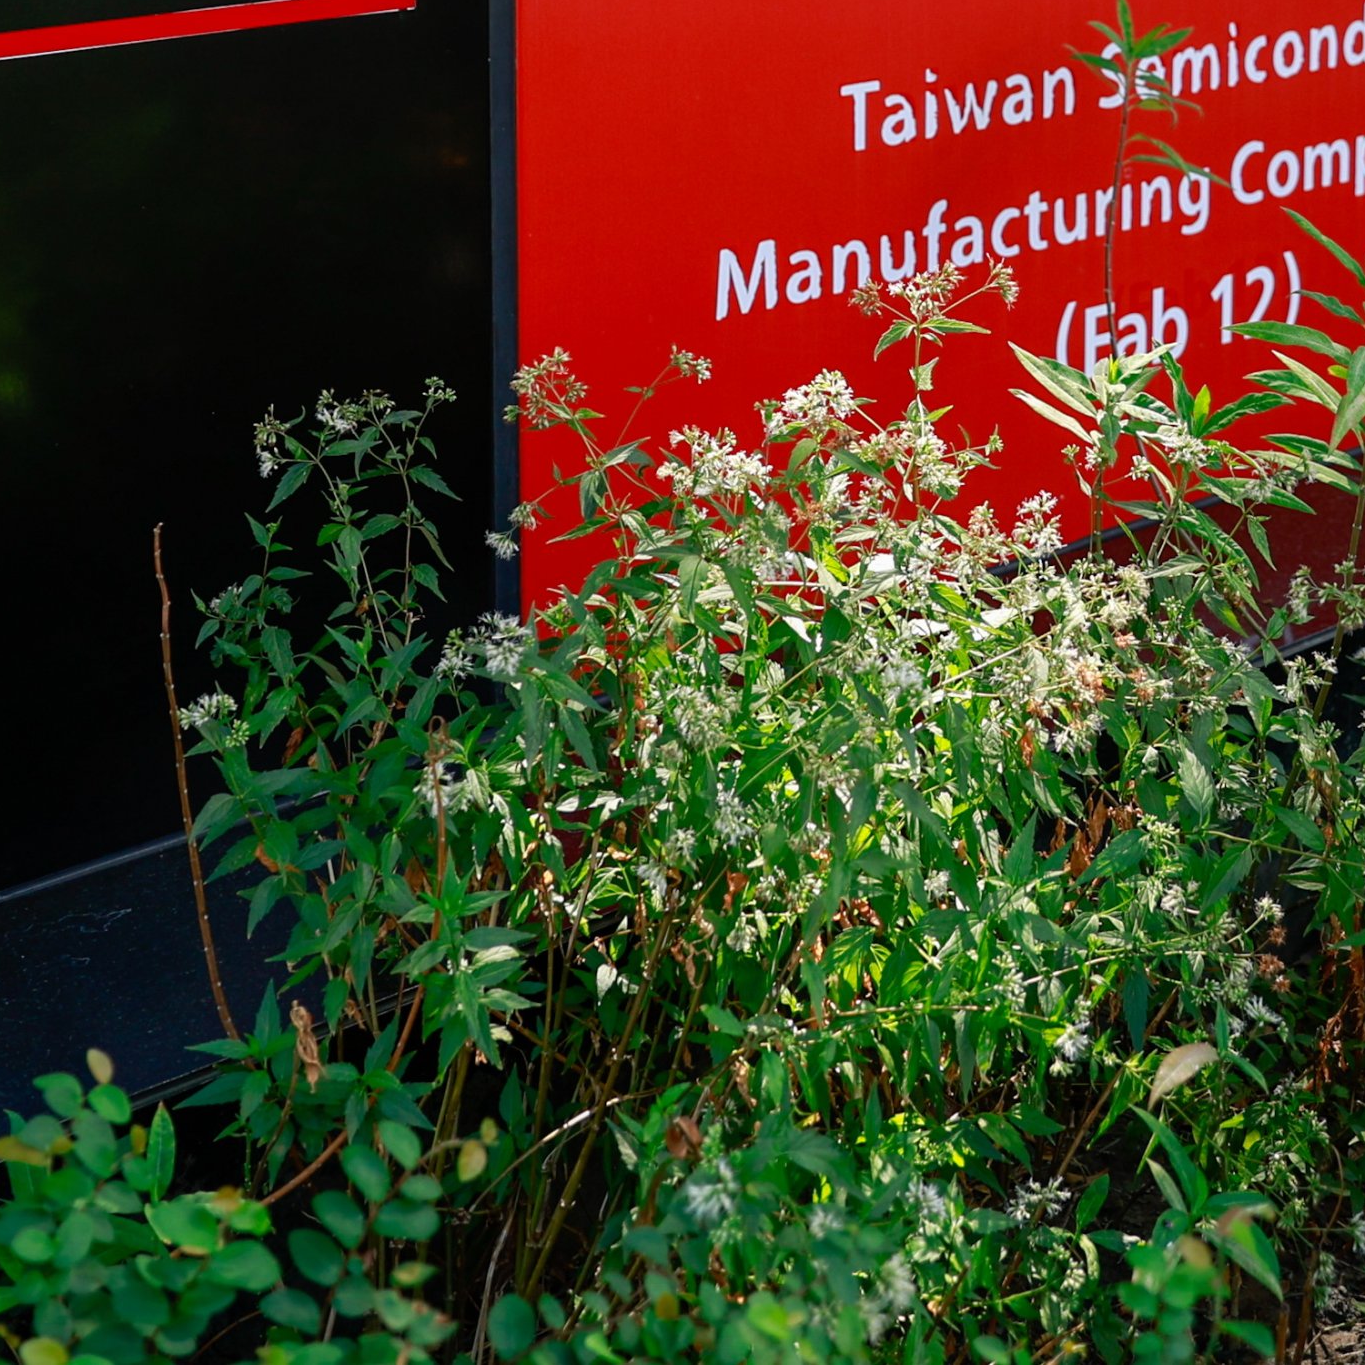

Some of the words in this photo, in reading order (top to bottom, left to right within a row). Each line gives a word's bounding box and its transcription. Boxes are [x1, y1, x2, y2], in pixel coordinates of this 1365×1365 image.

[840, 67, 1075, 152] Taiwan
[715, 167, 1212, 321] Manufacturing
[1055, 287, 1189, 379] (Fab
[1210, 251, 1301, 345] 12)
